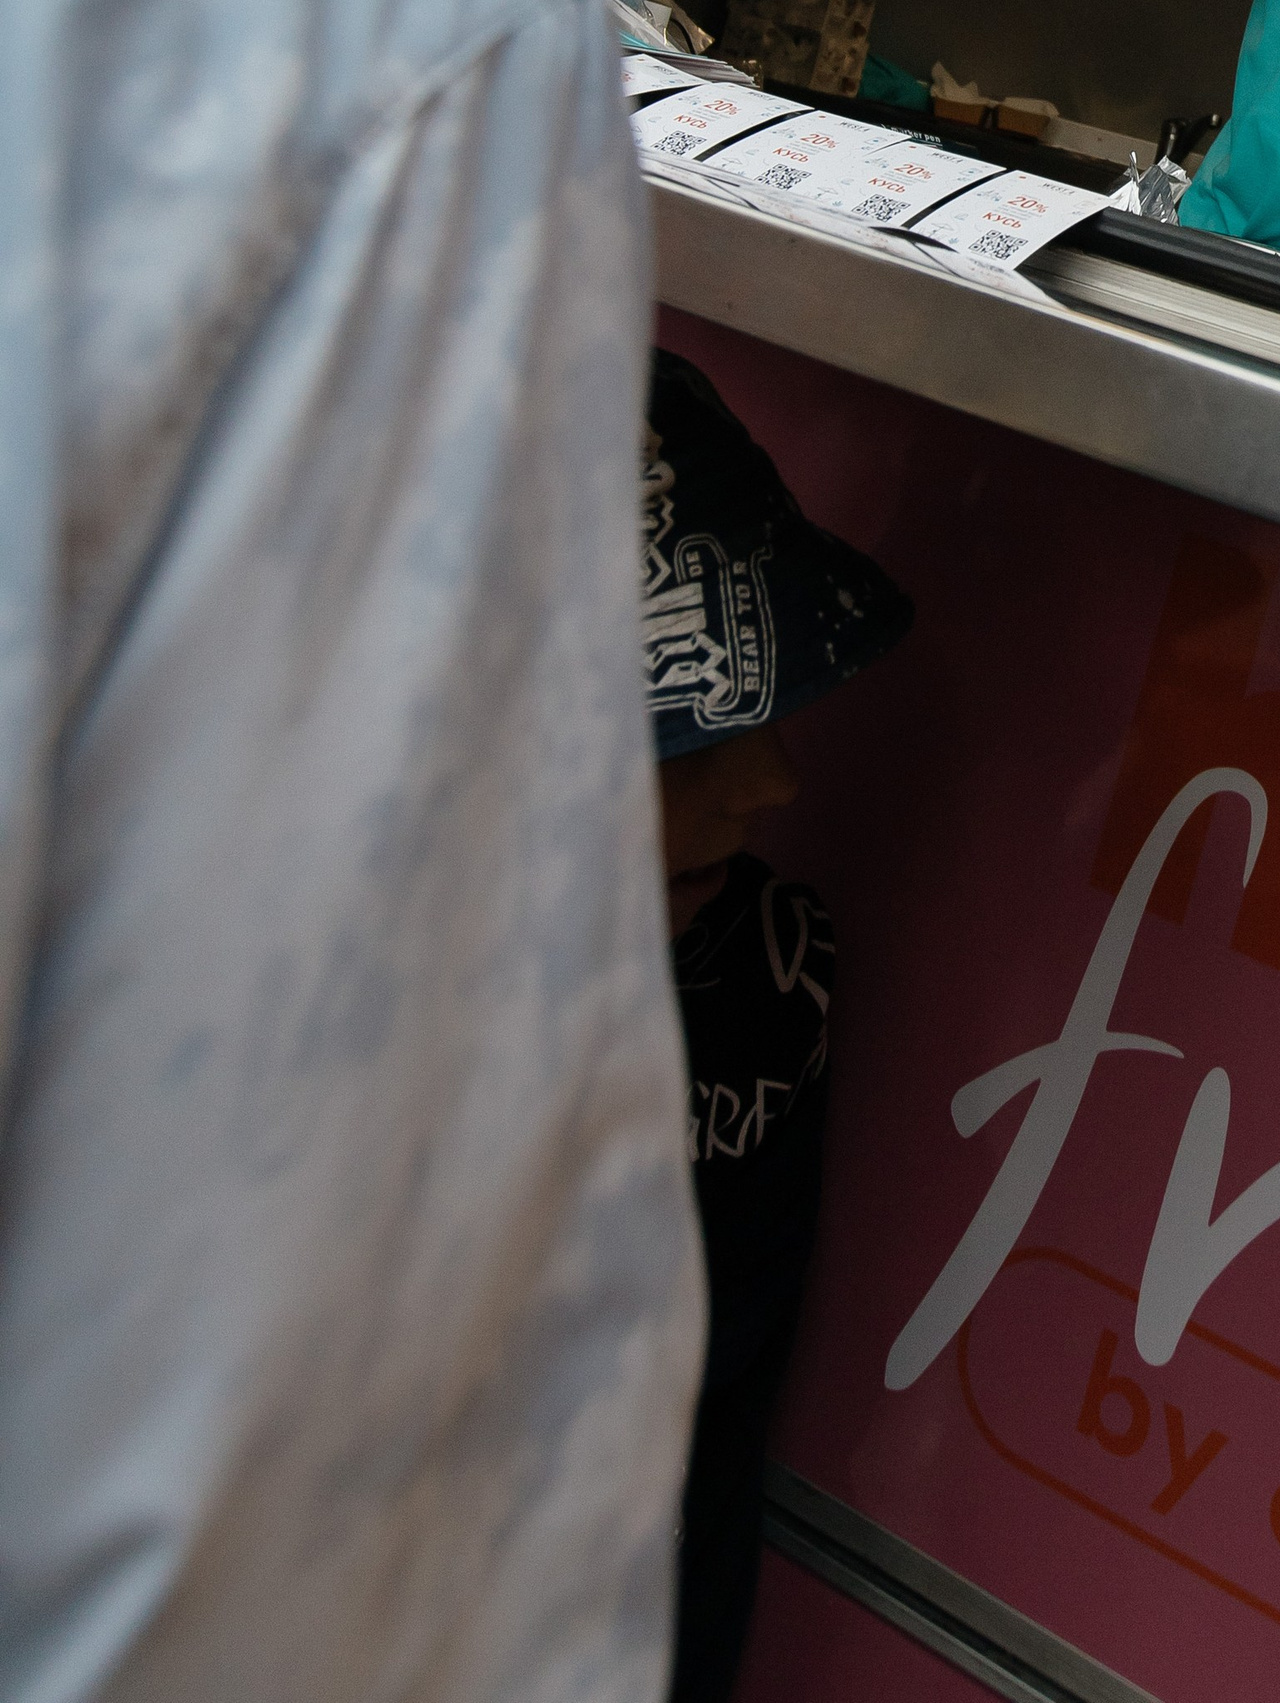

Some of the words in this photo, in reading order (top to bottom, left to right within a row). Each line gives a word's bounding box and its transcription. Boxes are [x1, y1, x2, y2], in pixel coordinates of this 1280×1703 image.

[704, 99, 742, 116] 20%
[673, 114, 707, 129] КУСЬ
[800, 133, 840, 149] 20%
[923, 133, 942, 144] pen
[772, 147, 809, 163] КУСЬ
[894, 163, 936, 180] 20%
[868, 177, 906, 193] КУСЬ
[1007, 196, 1048, 213] 20%
[982, 212, 1022, 229] КУСЬ
[1075, 1330, 1230, 1515] by
